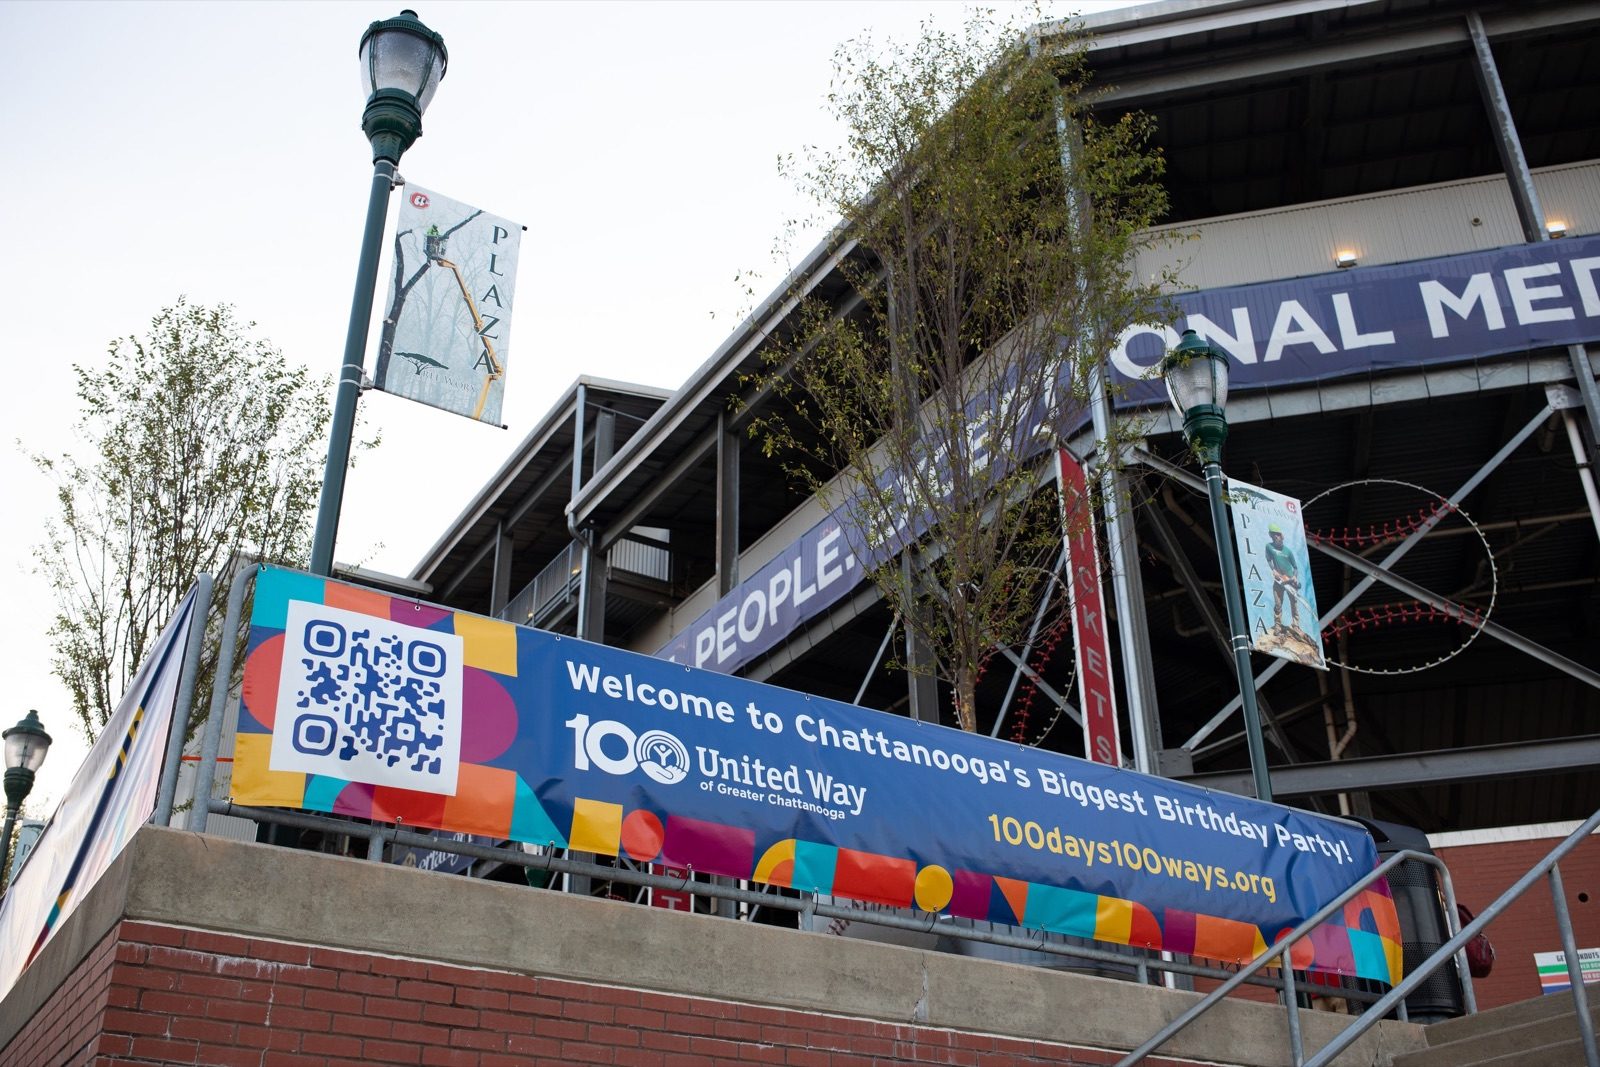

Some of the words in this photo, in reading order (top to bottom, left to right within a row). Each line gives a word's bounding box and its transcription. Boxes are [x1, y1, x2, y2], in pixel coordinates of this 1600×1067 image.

[473, 225, 509, 375] PLAZA
[1110, 293, 1396, 380] ONAL
[695, 526, 856, 669] PEOPLE.
[1240, 513, 1268, 635] PLAZA
[565, 713, 691, 785] 100
[695, 746, 804, 795] United
[805, 769, 867, 816] Way
[566, 660, 735, 723] Welcome
[746, 702, 784, 734] to
[795, 714, 1031, 788] Chattanooga's
[1037, 768, 1149, 816] Biggest
[1154, 795, 1269, 848] Birthday
[1274, 823, 1353, 865] Party!
[700, 781, 714, 792] of
[717, 783, 765, 802] Greater
[768, 794, 846, 820] Chattanooga
[988, 813, 1276, 903] 100days100ways.org
